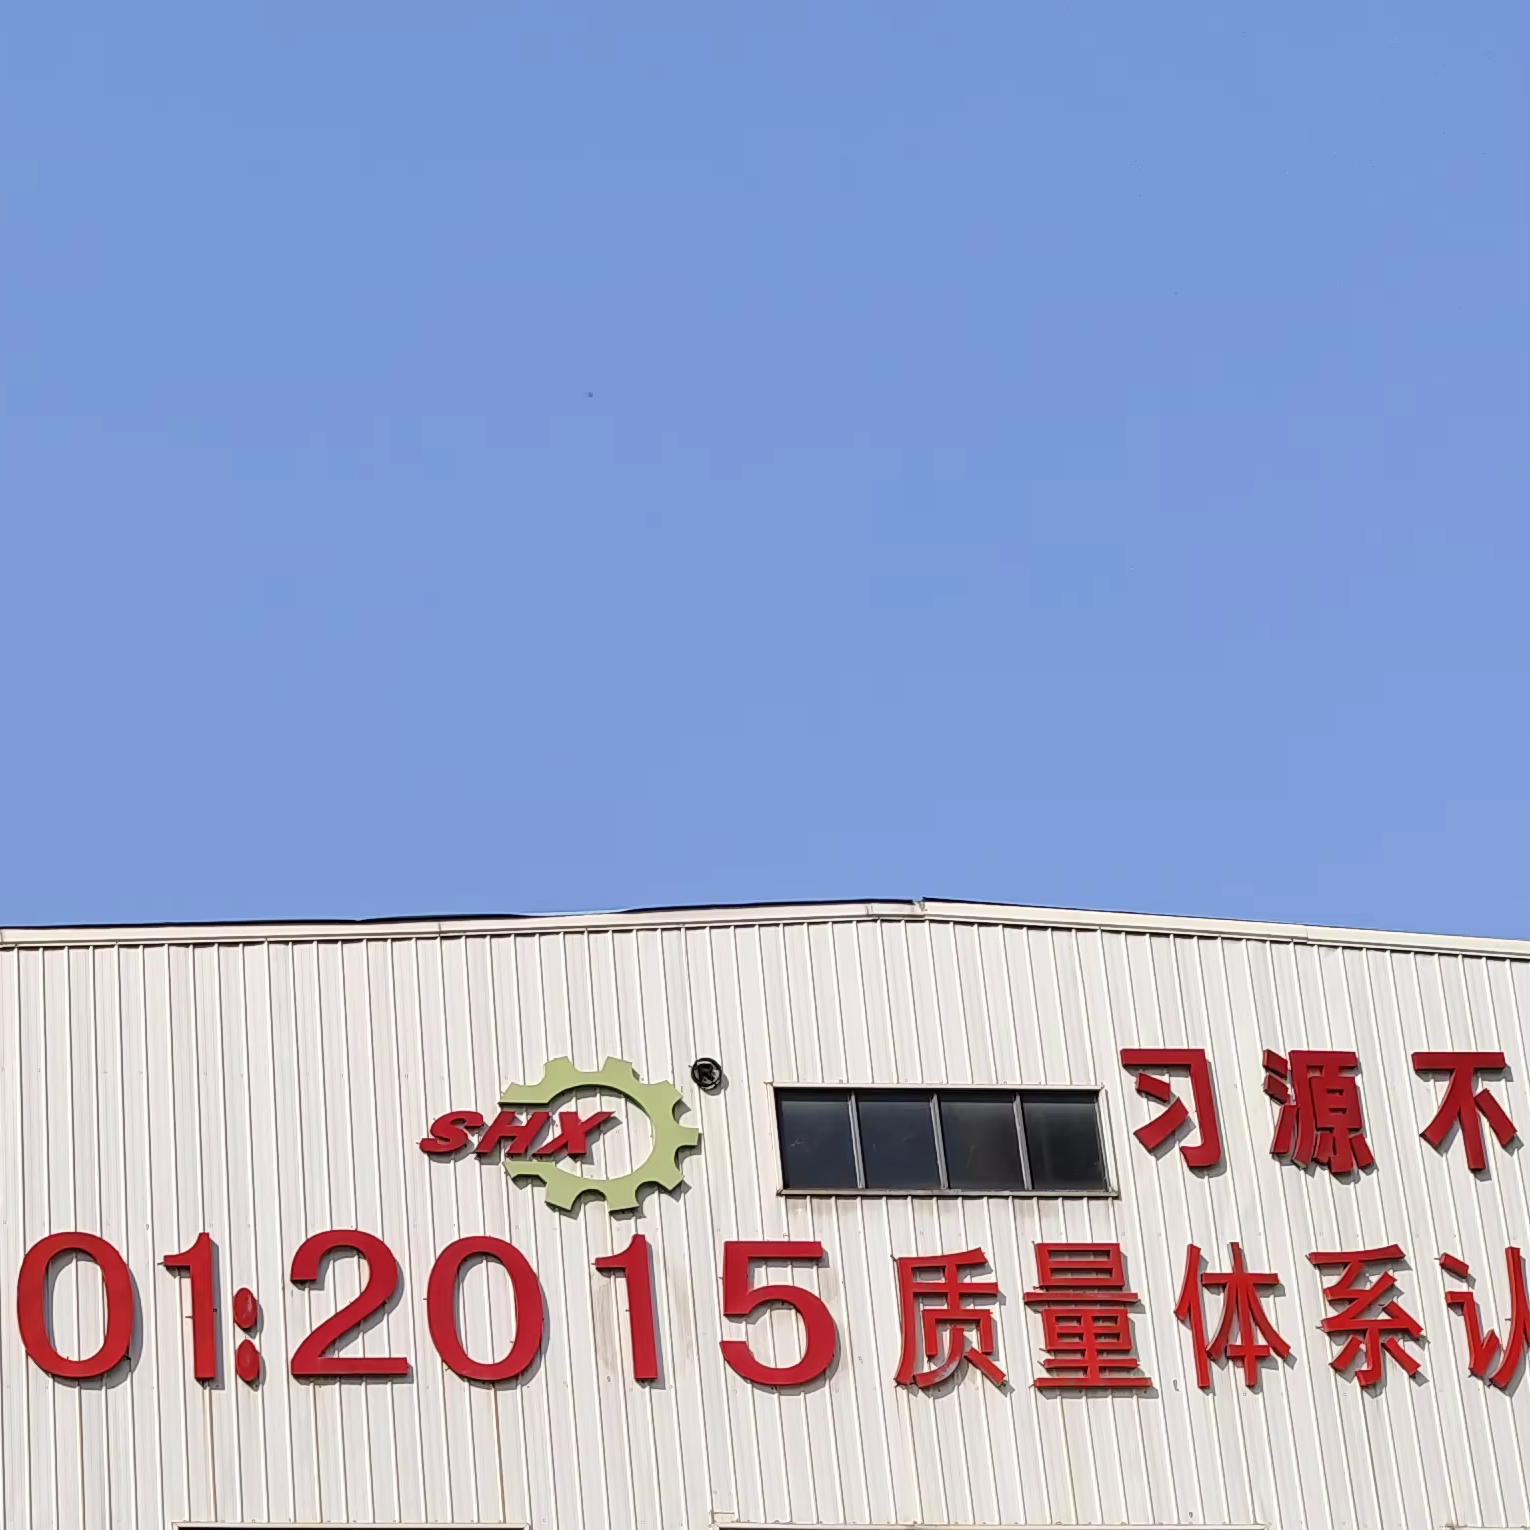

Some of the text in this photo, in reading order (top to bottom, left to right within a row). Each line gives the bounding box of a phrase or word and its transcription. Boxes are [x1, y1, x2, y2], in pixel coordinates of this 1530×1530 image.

[420, 1109, 615, 1161] SHX
[1120, 1048, 1517, 1174] 习源不
